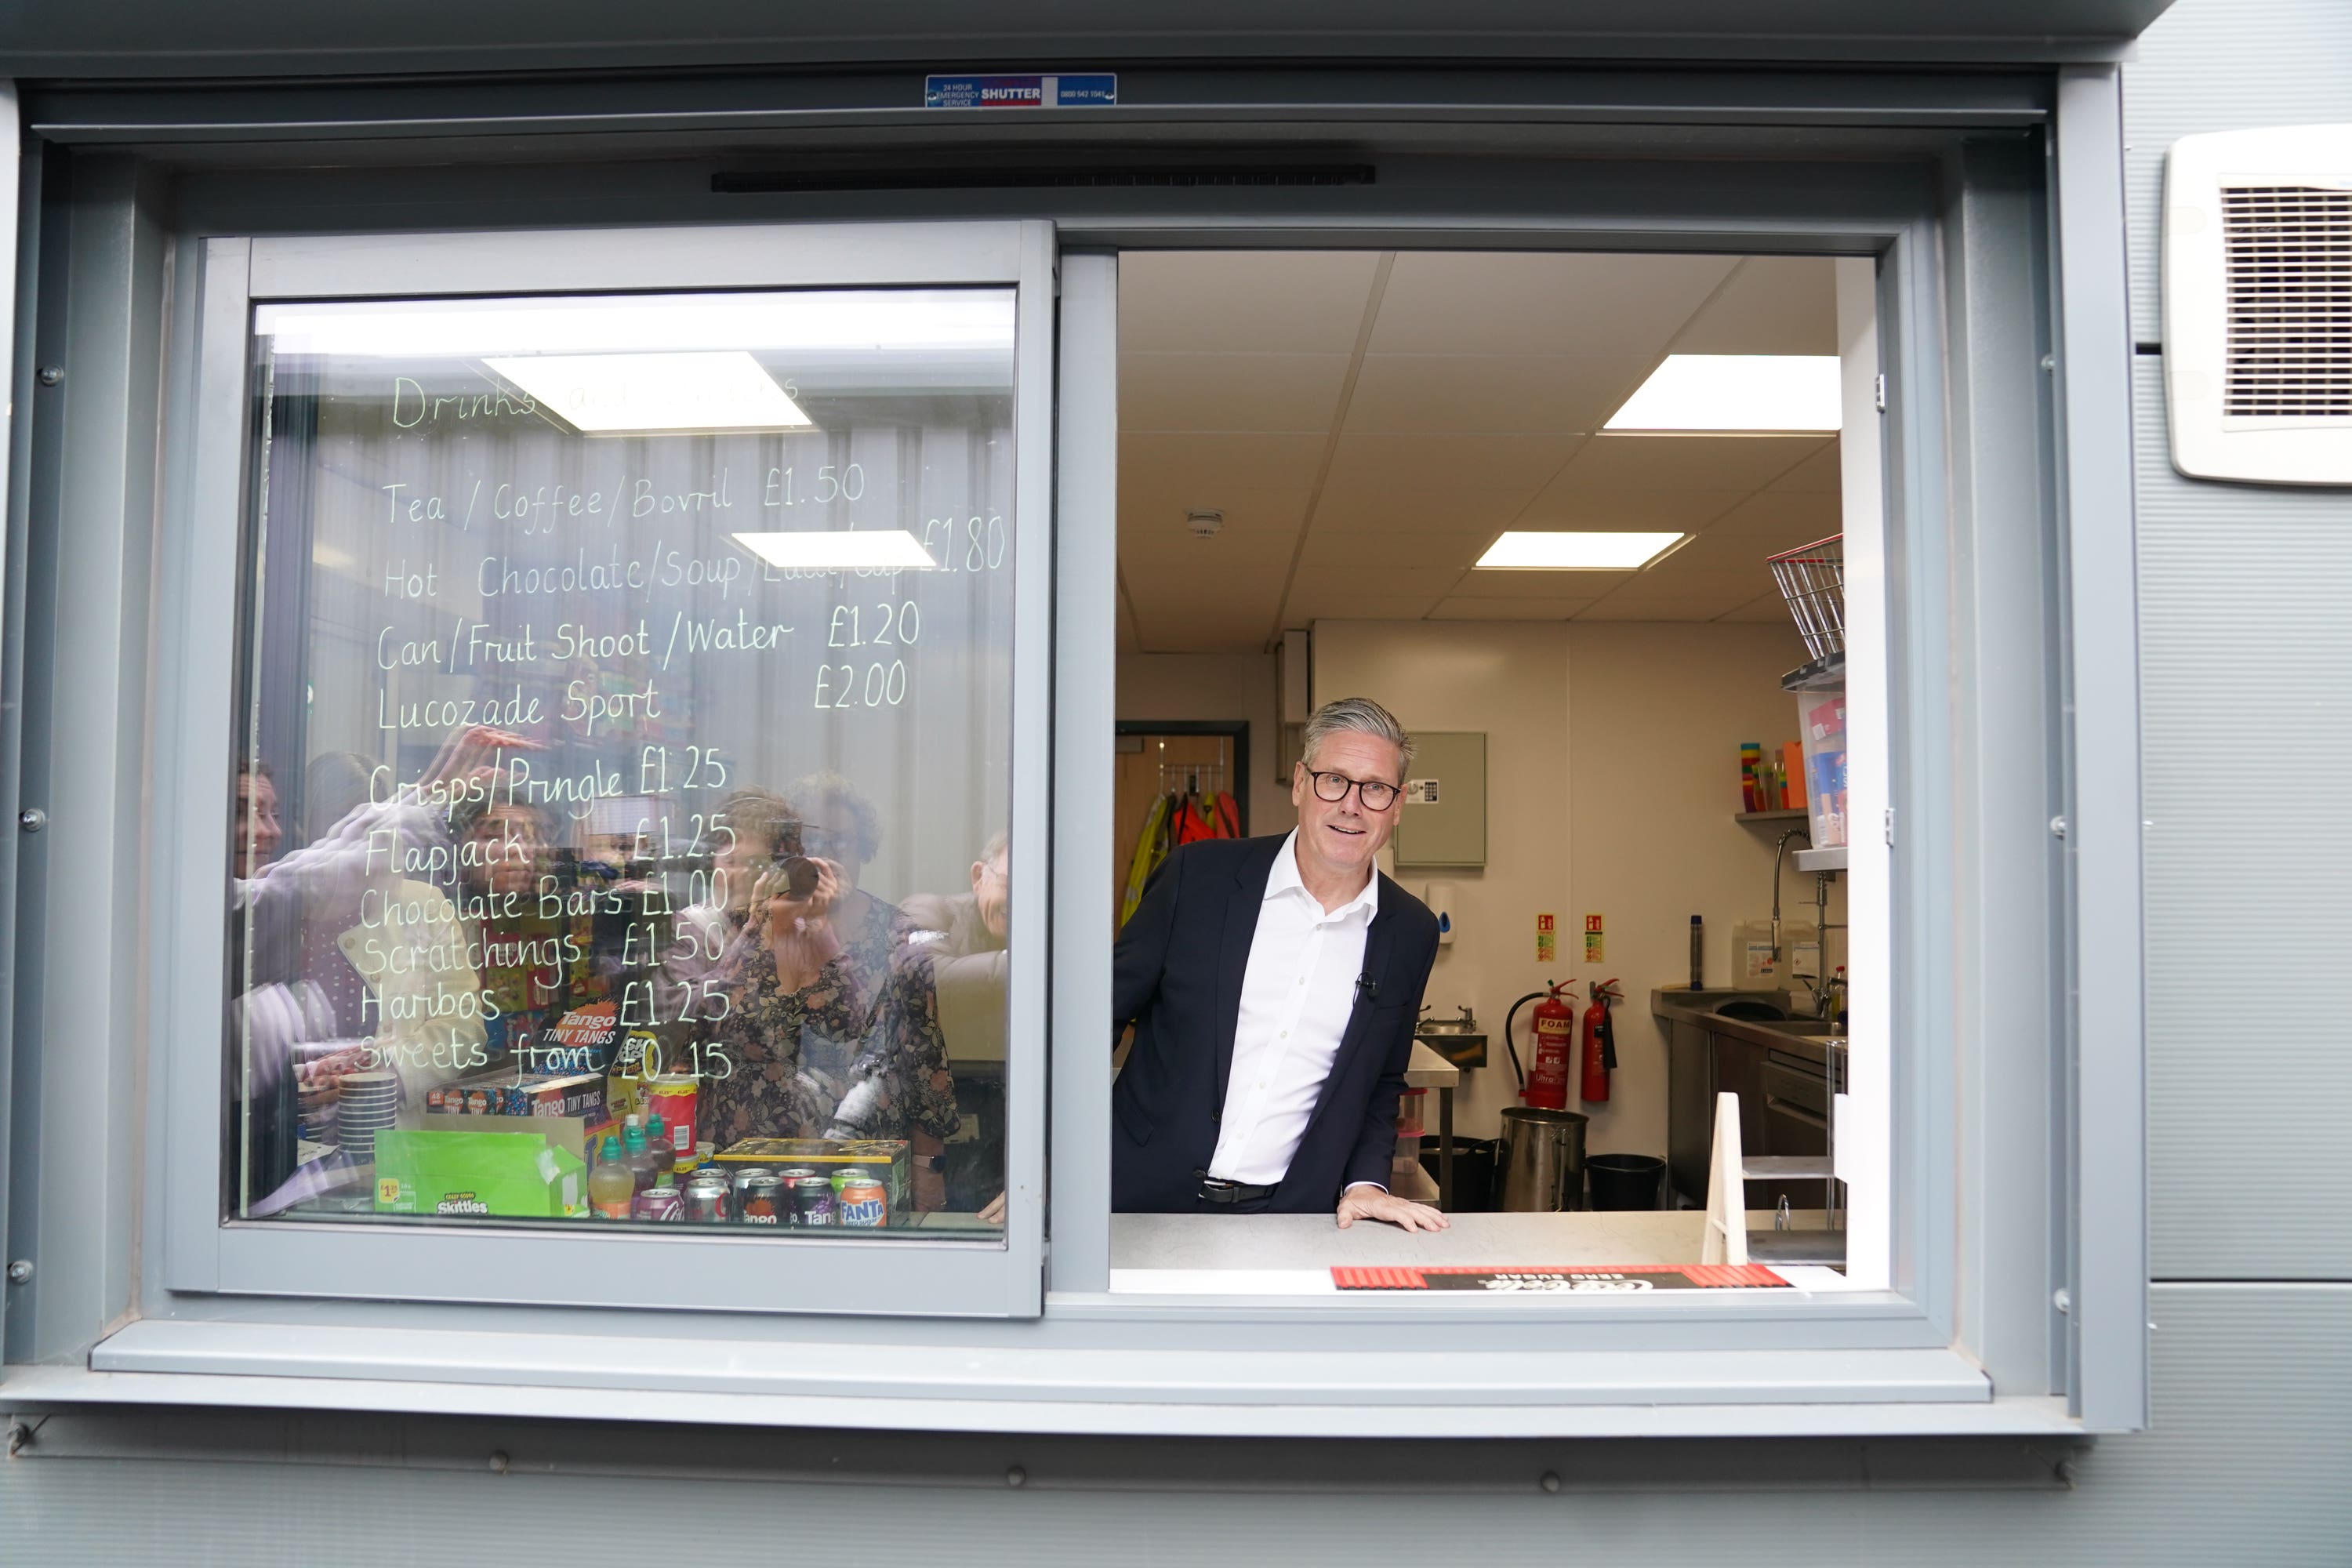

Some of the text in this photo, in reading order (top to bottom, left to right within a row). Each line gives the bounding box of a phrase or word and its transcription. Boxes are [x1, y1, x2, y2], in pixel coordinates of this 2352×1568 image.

[936, 91, 979, 100] EMERGENCY
[953, 83, 973, 92] HOUR
[981, 88, 1040, 100] SHUTTER
[942, 99, 972, 107] SERVICE
[394, 376, 537, 428] Drinks
[382, 483, 445, 523] Tea
[764, 463, 865, 507] £1.50
[384, 558, 438, 599] Hot
[920, 515, 1005, 573] £1.80
[377, 617, 538, 673] Can/Fruit
[551, 619, 651, 661] Shoot
[828, 601, 920, 647] £1.20
[378, 659, 906, 736] Lucozade Sport £2.00
[639, 745, 728, 794] £1.25
[365, 813, 736, 887] Flapjack £1.25
[361, 882, 513, 930] Chocolate
[538, 875, 623, 920] Bars
[355, 921, 724, 990] Scratchings £1.50
[361, 979, 731, 1028] Haribos £1.25
[562, 1011, 617, 1030] Tango
[1541, 1019, 1570, 1028] FOAM
[543, 1028, 616, 1045] TINY TANGS
[354, 1028, 488, 1070] Sweets
[506, 1033, 607, 1090] from
[620, 1034, 732, 1083] £0.15
[445, 1095, 464, 1105] Tango
[468, 1097, 487, 1107] Tango
[532, 1098, 565, 1117] Tango
[567, 1094, 582, 1112] TINY
[583, 1091, 601, 1108] TANGS
[437, 1200, 488, 1214] Skittles
[840, 1200, 884, 1220] FANTA
